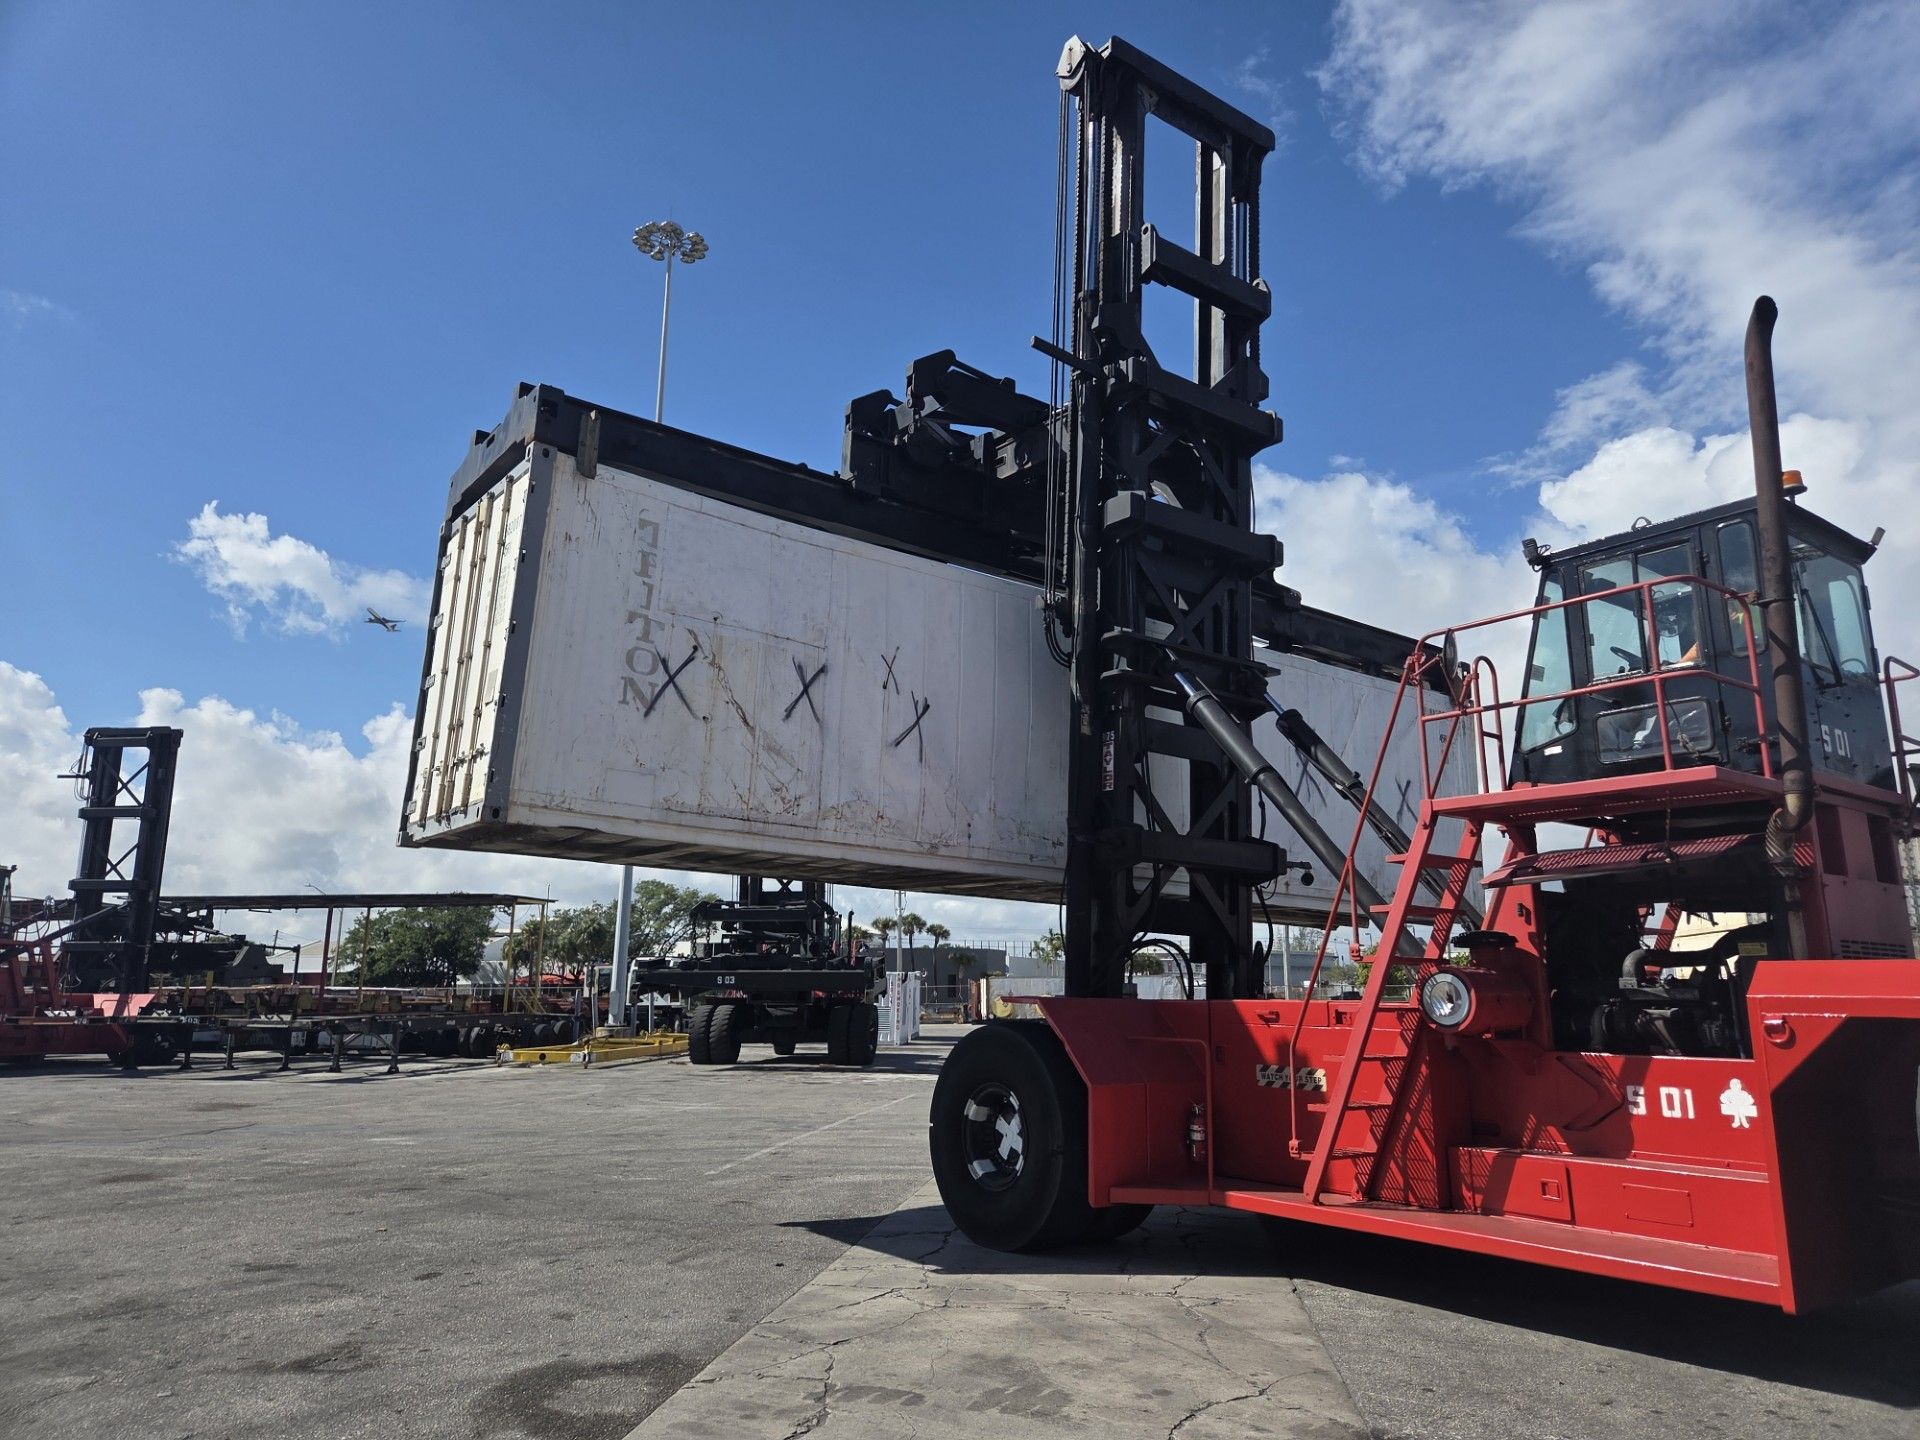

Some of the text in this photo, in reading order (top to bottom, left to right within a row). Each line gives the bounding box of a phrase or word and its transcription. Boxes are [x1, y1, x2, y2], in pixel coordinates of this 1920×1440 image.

[1820, 724, 1850, 758] S 01
[1103, 741, 1113, 790] TAYLOR
[717, 976, 735, 984] S 03
[1261, 1073, 1283, 1081] WATCH
[1305, 1076, 1323, 1084] STEP
[1626, 1085, 1695, 1119] S 01
